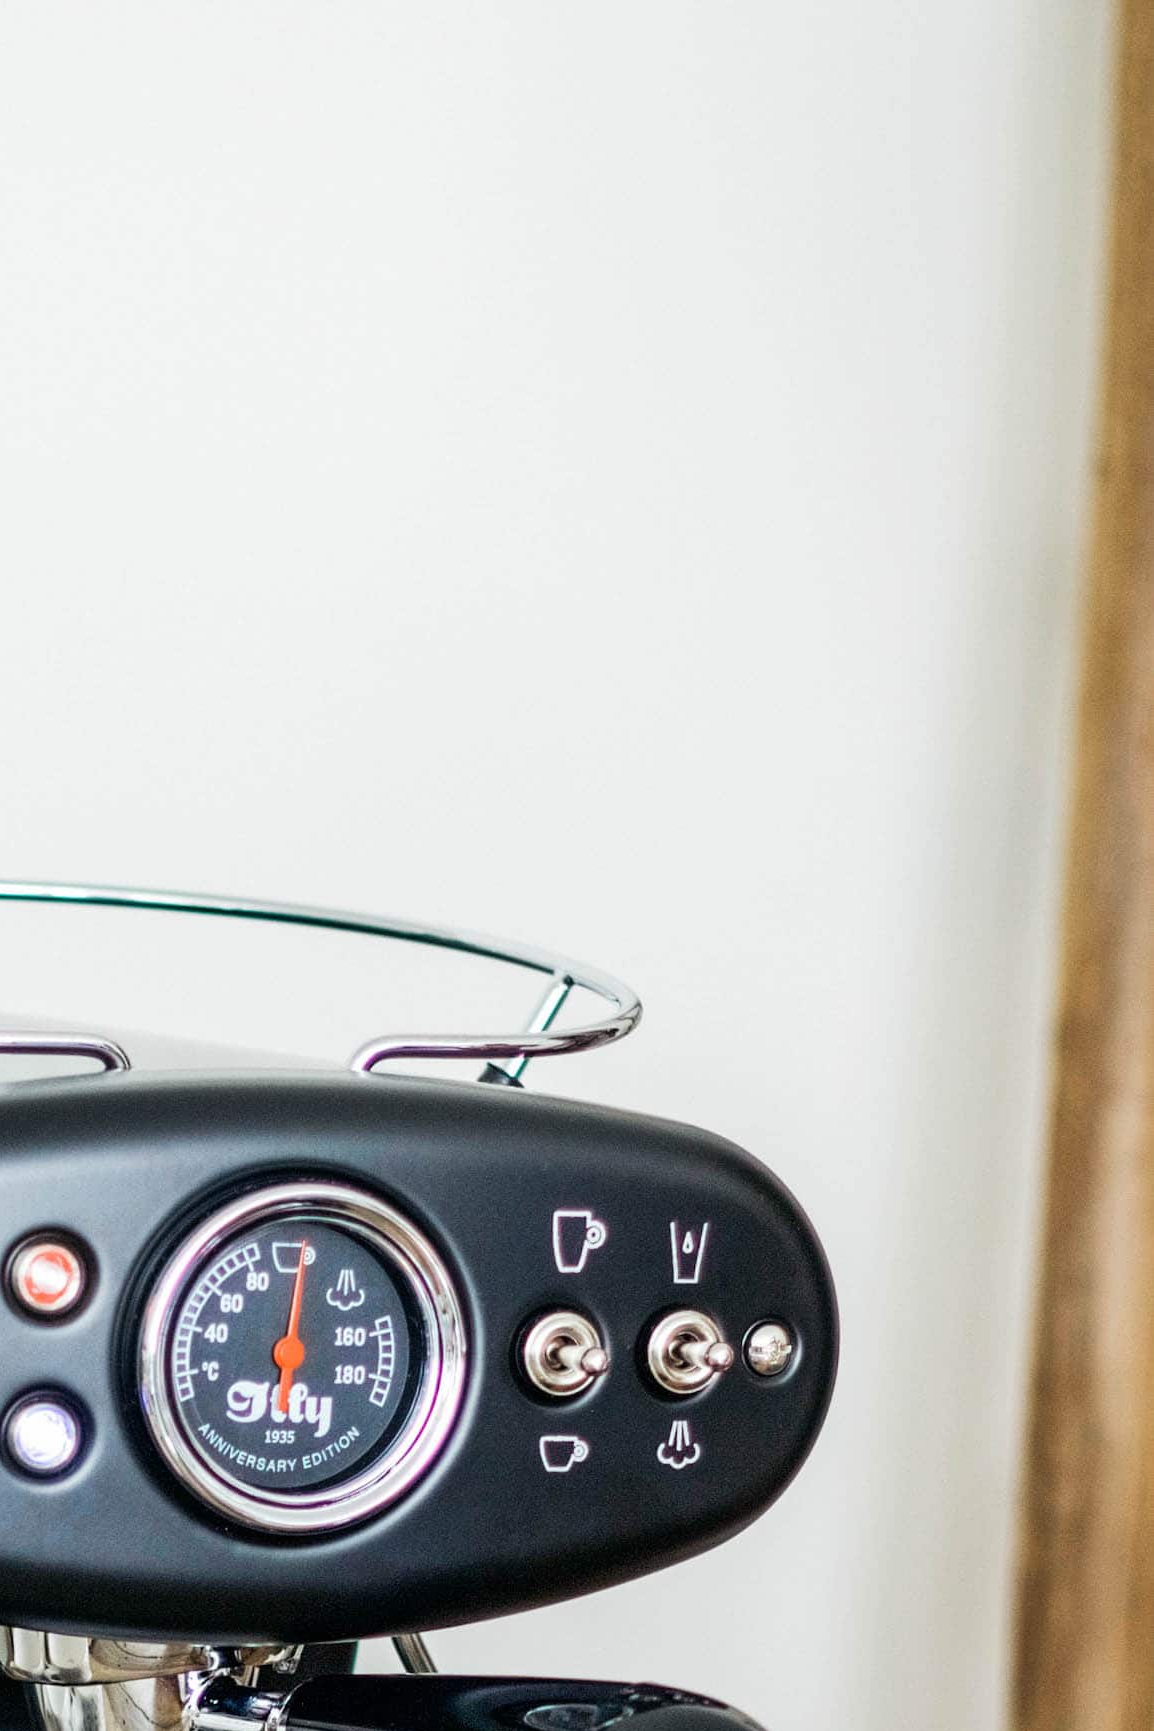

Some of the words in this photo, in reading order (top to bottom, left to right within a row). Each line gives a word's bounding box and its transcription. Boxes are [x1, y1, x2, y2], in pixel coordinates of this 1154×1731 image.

[246, 1272, 270, 1291] 80
[220, 1294, 243, 1313] 60
[204, 1323, 228, 1343] 40
[334, 1328, 366, 1346] 160
[334, 1365, 365, 1384] 180
[264, 1430, 295, 1444] 1935
[197, 1423, 297, 1473] ANNIVERSARY
[302, 1426, 360, 1470] EDITION
